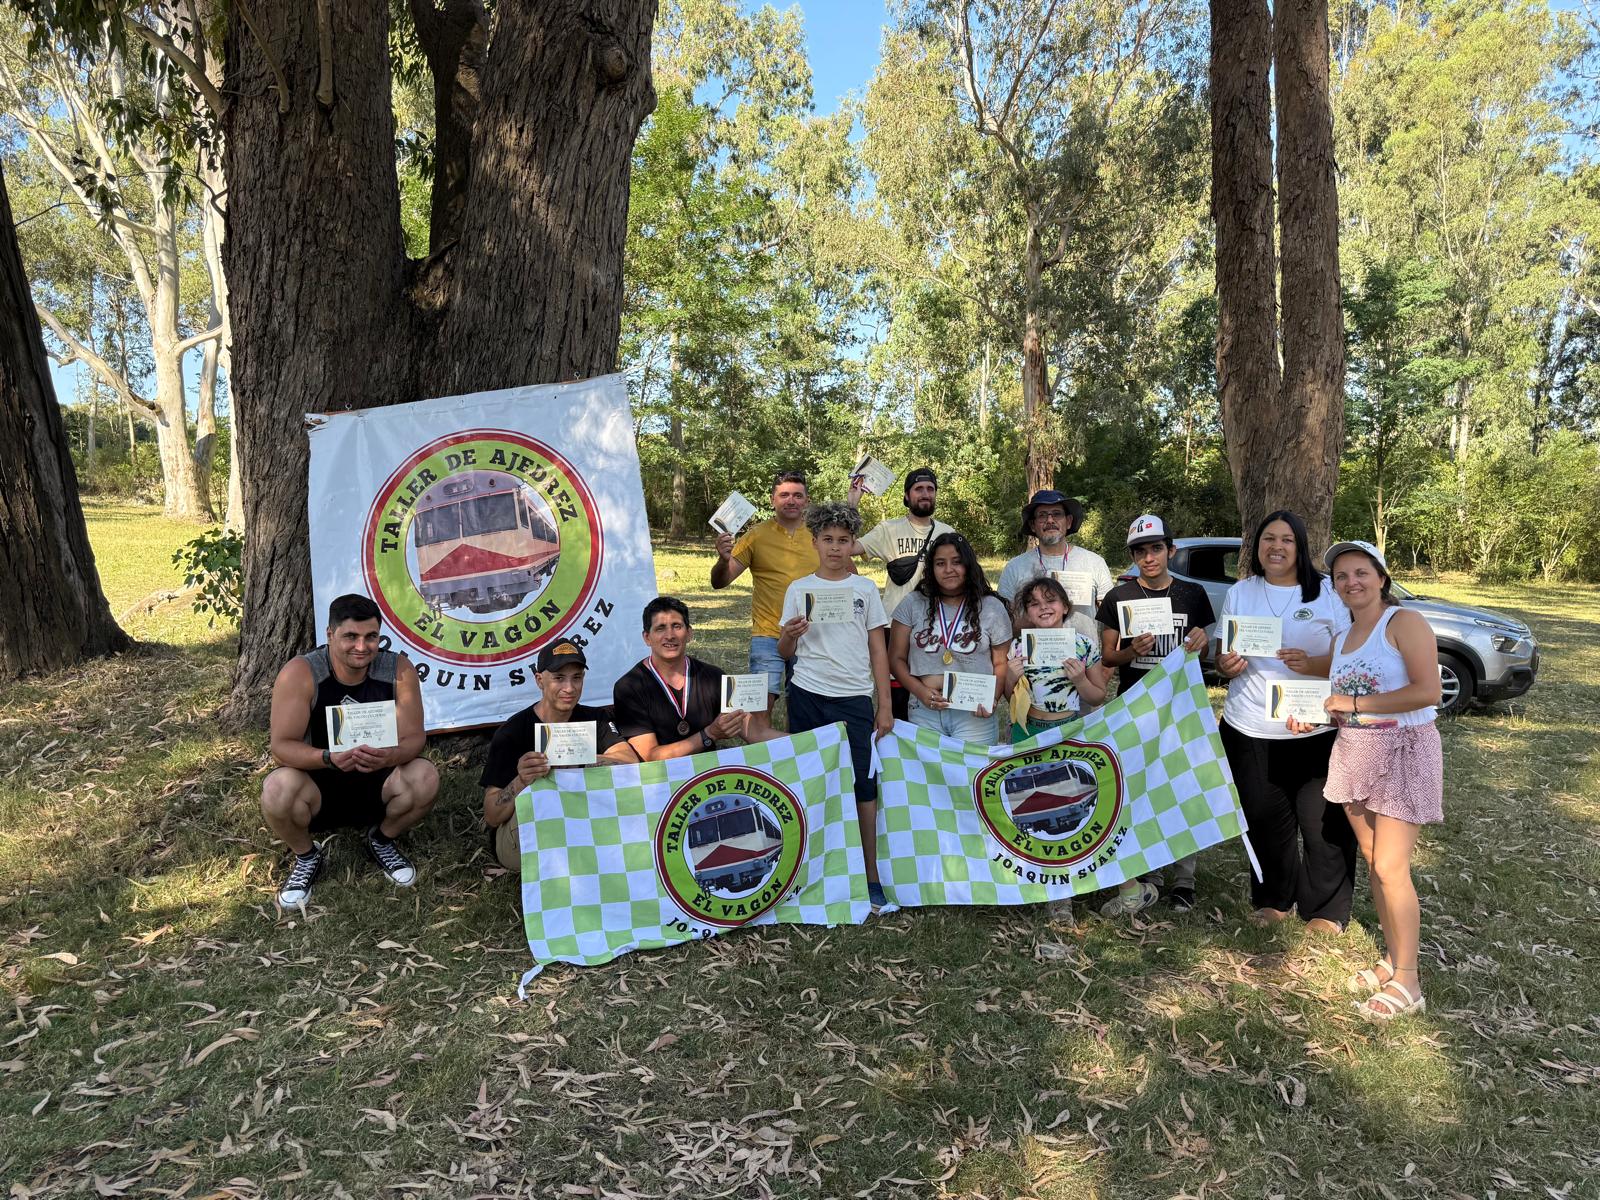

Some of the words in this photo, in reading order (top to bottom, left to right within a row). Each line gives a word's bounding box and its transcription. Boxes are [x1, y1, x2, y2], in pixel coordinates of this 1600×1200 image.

[381, 468, 438, 553] TALLER
[445, 449, 477, 471] DE
[489, 449, 578, 522] AJEDREZ
[413, 612, 444, 642] EL
[459, 599, 561, 648] VAGÓN
[378, 634, 492, 691] OQUIN
[985, 763, 1016, 797] TALLER
[1023, 754, 1042, 765] DE
[1050, 749, 1106, 770] AJEDREZ
[667, 793, 701, 853] TALLER
[705, 780, 726, 795] DE
[734, 779, 794, 824] AJEDREZ
[1012, 833, 1032, 851] EL
[1042, 821, 1103, 856] VAGÓN
[993, 852, 1070, 885] JOAQUIN
[1077, 826, 1128, 879] SUÁREZ
[692, 893, 713, 912] EL
[721, 878, 783, 916] VAGÓN
